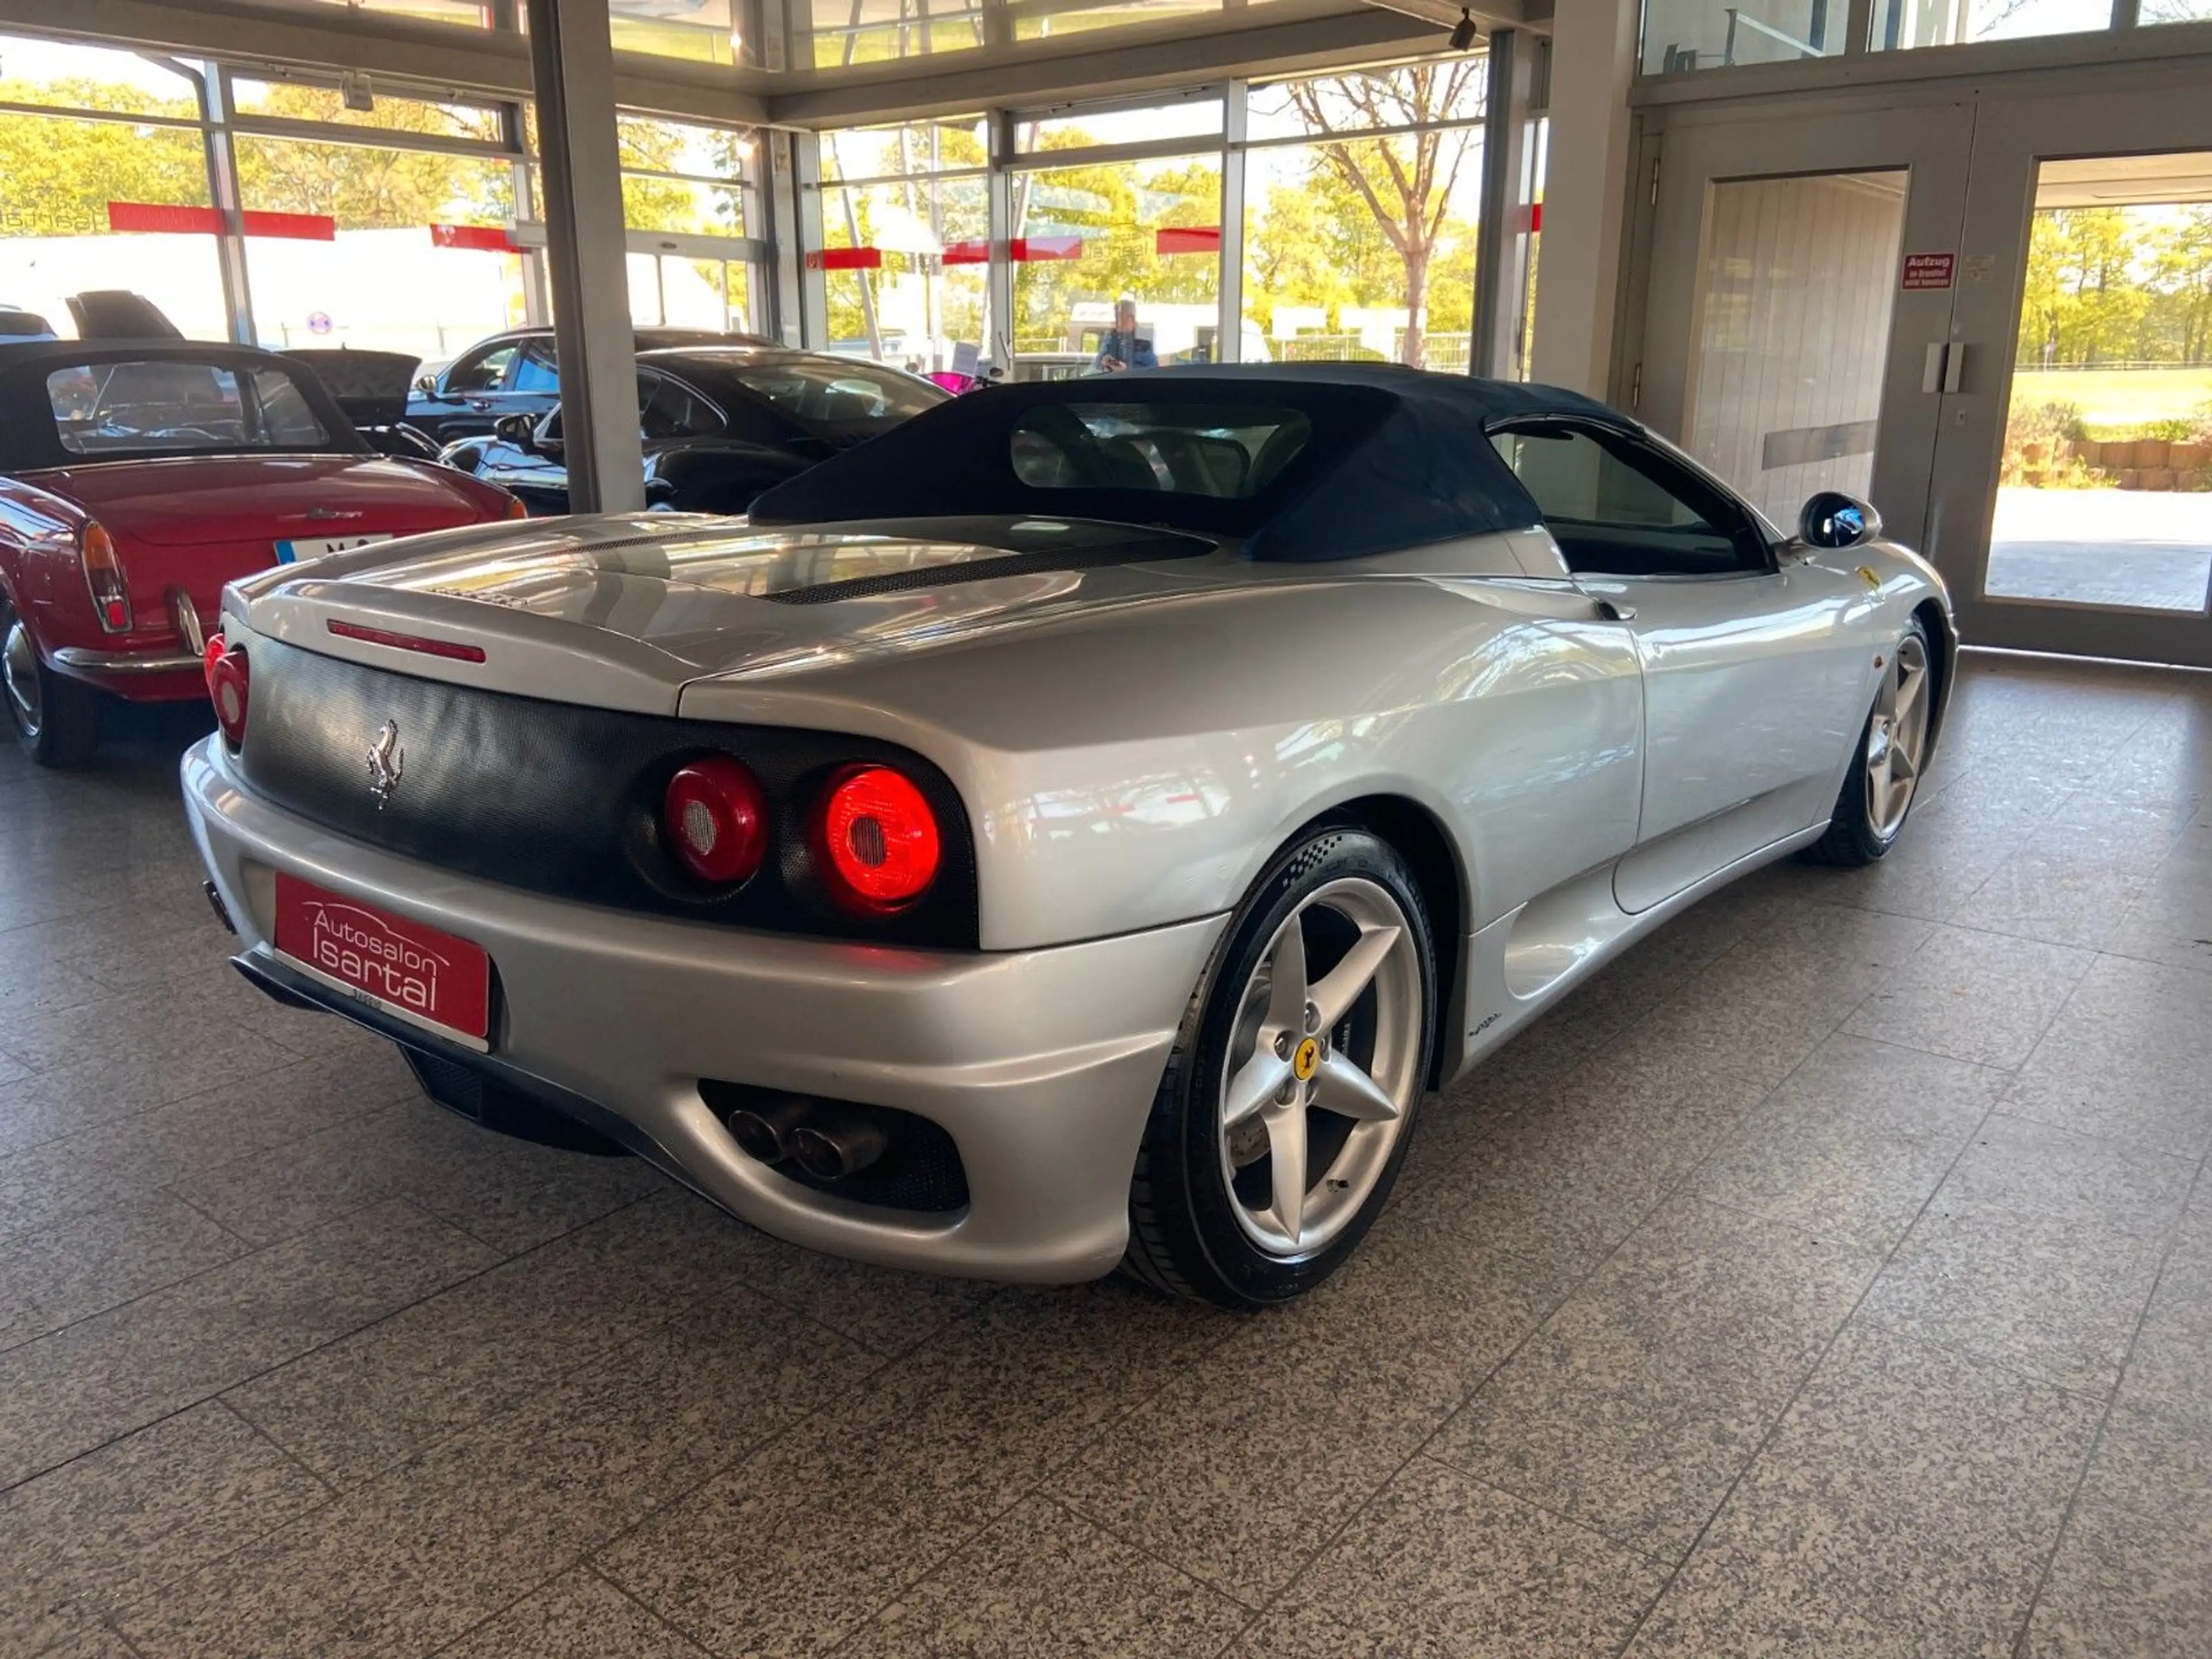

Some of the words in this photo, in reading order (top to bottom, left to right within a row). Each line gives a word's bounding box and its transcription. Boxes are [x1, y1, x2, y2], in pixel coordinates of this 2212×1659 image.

[1908, 256, 1950, 268] Aufzug
[313, 909, 437, 977] Autosalon
[313, 926, 437, 1012] Isartal
